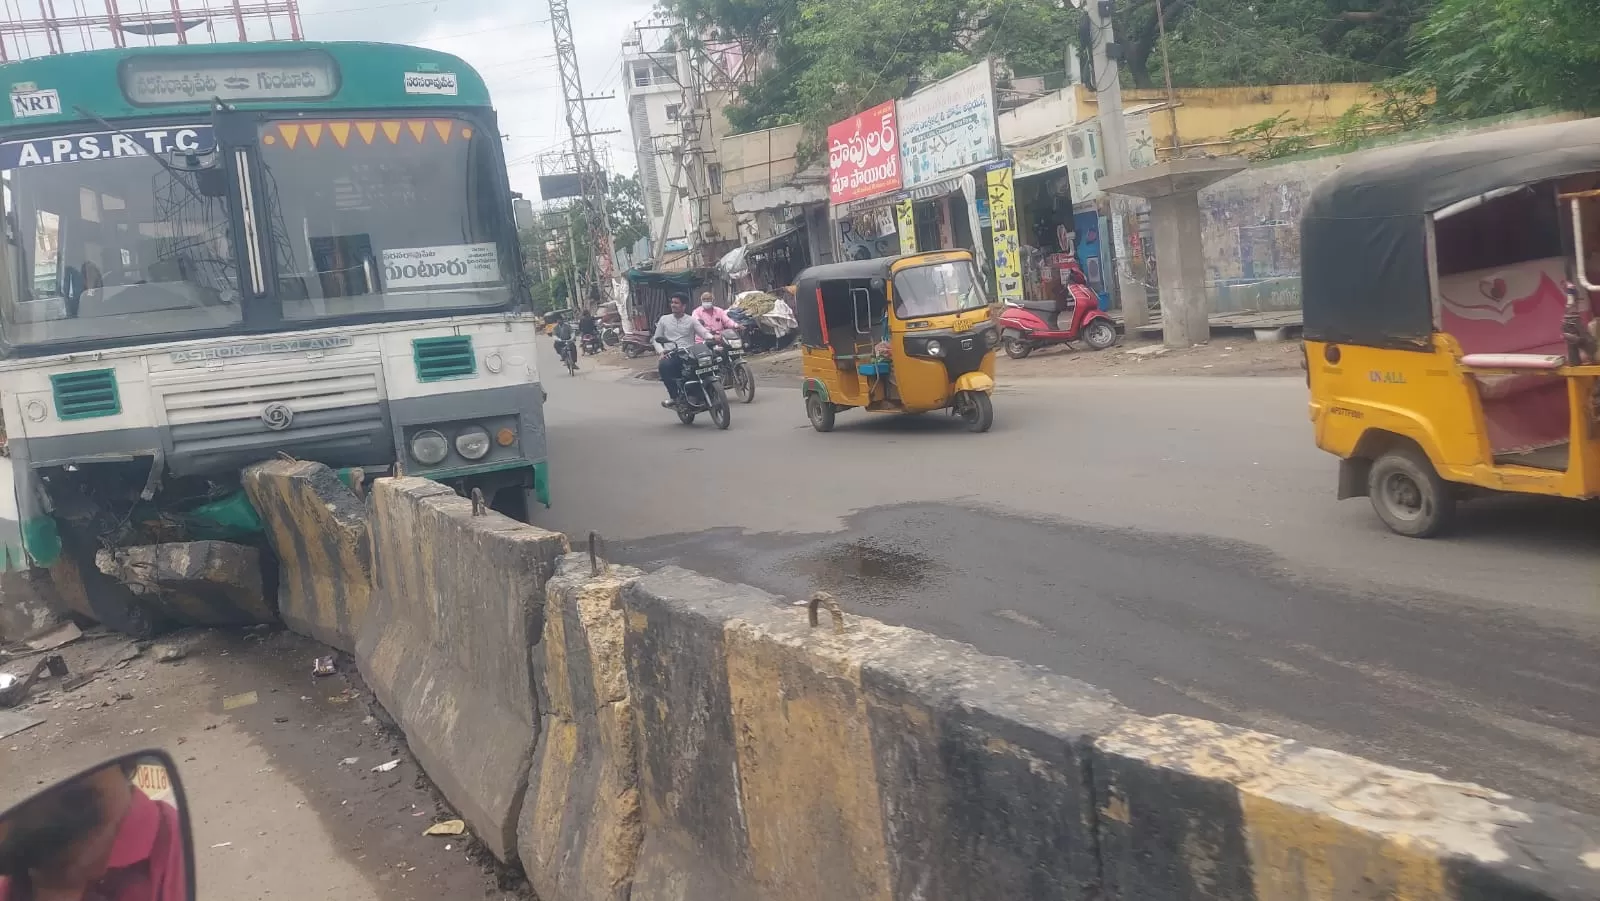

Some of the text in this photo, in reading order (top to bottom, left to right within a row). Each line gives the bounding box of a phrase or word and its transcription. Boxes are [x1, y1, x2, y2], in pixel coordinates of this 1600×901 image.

[12, 94, 55, 113] NRT
[173, 336, 352, 362] ASHOK LEYLAND
